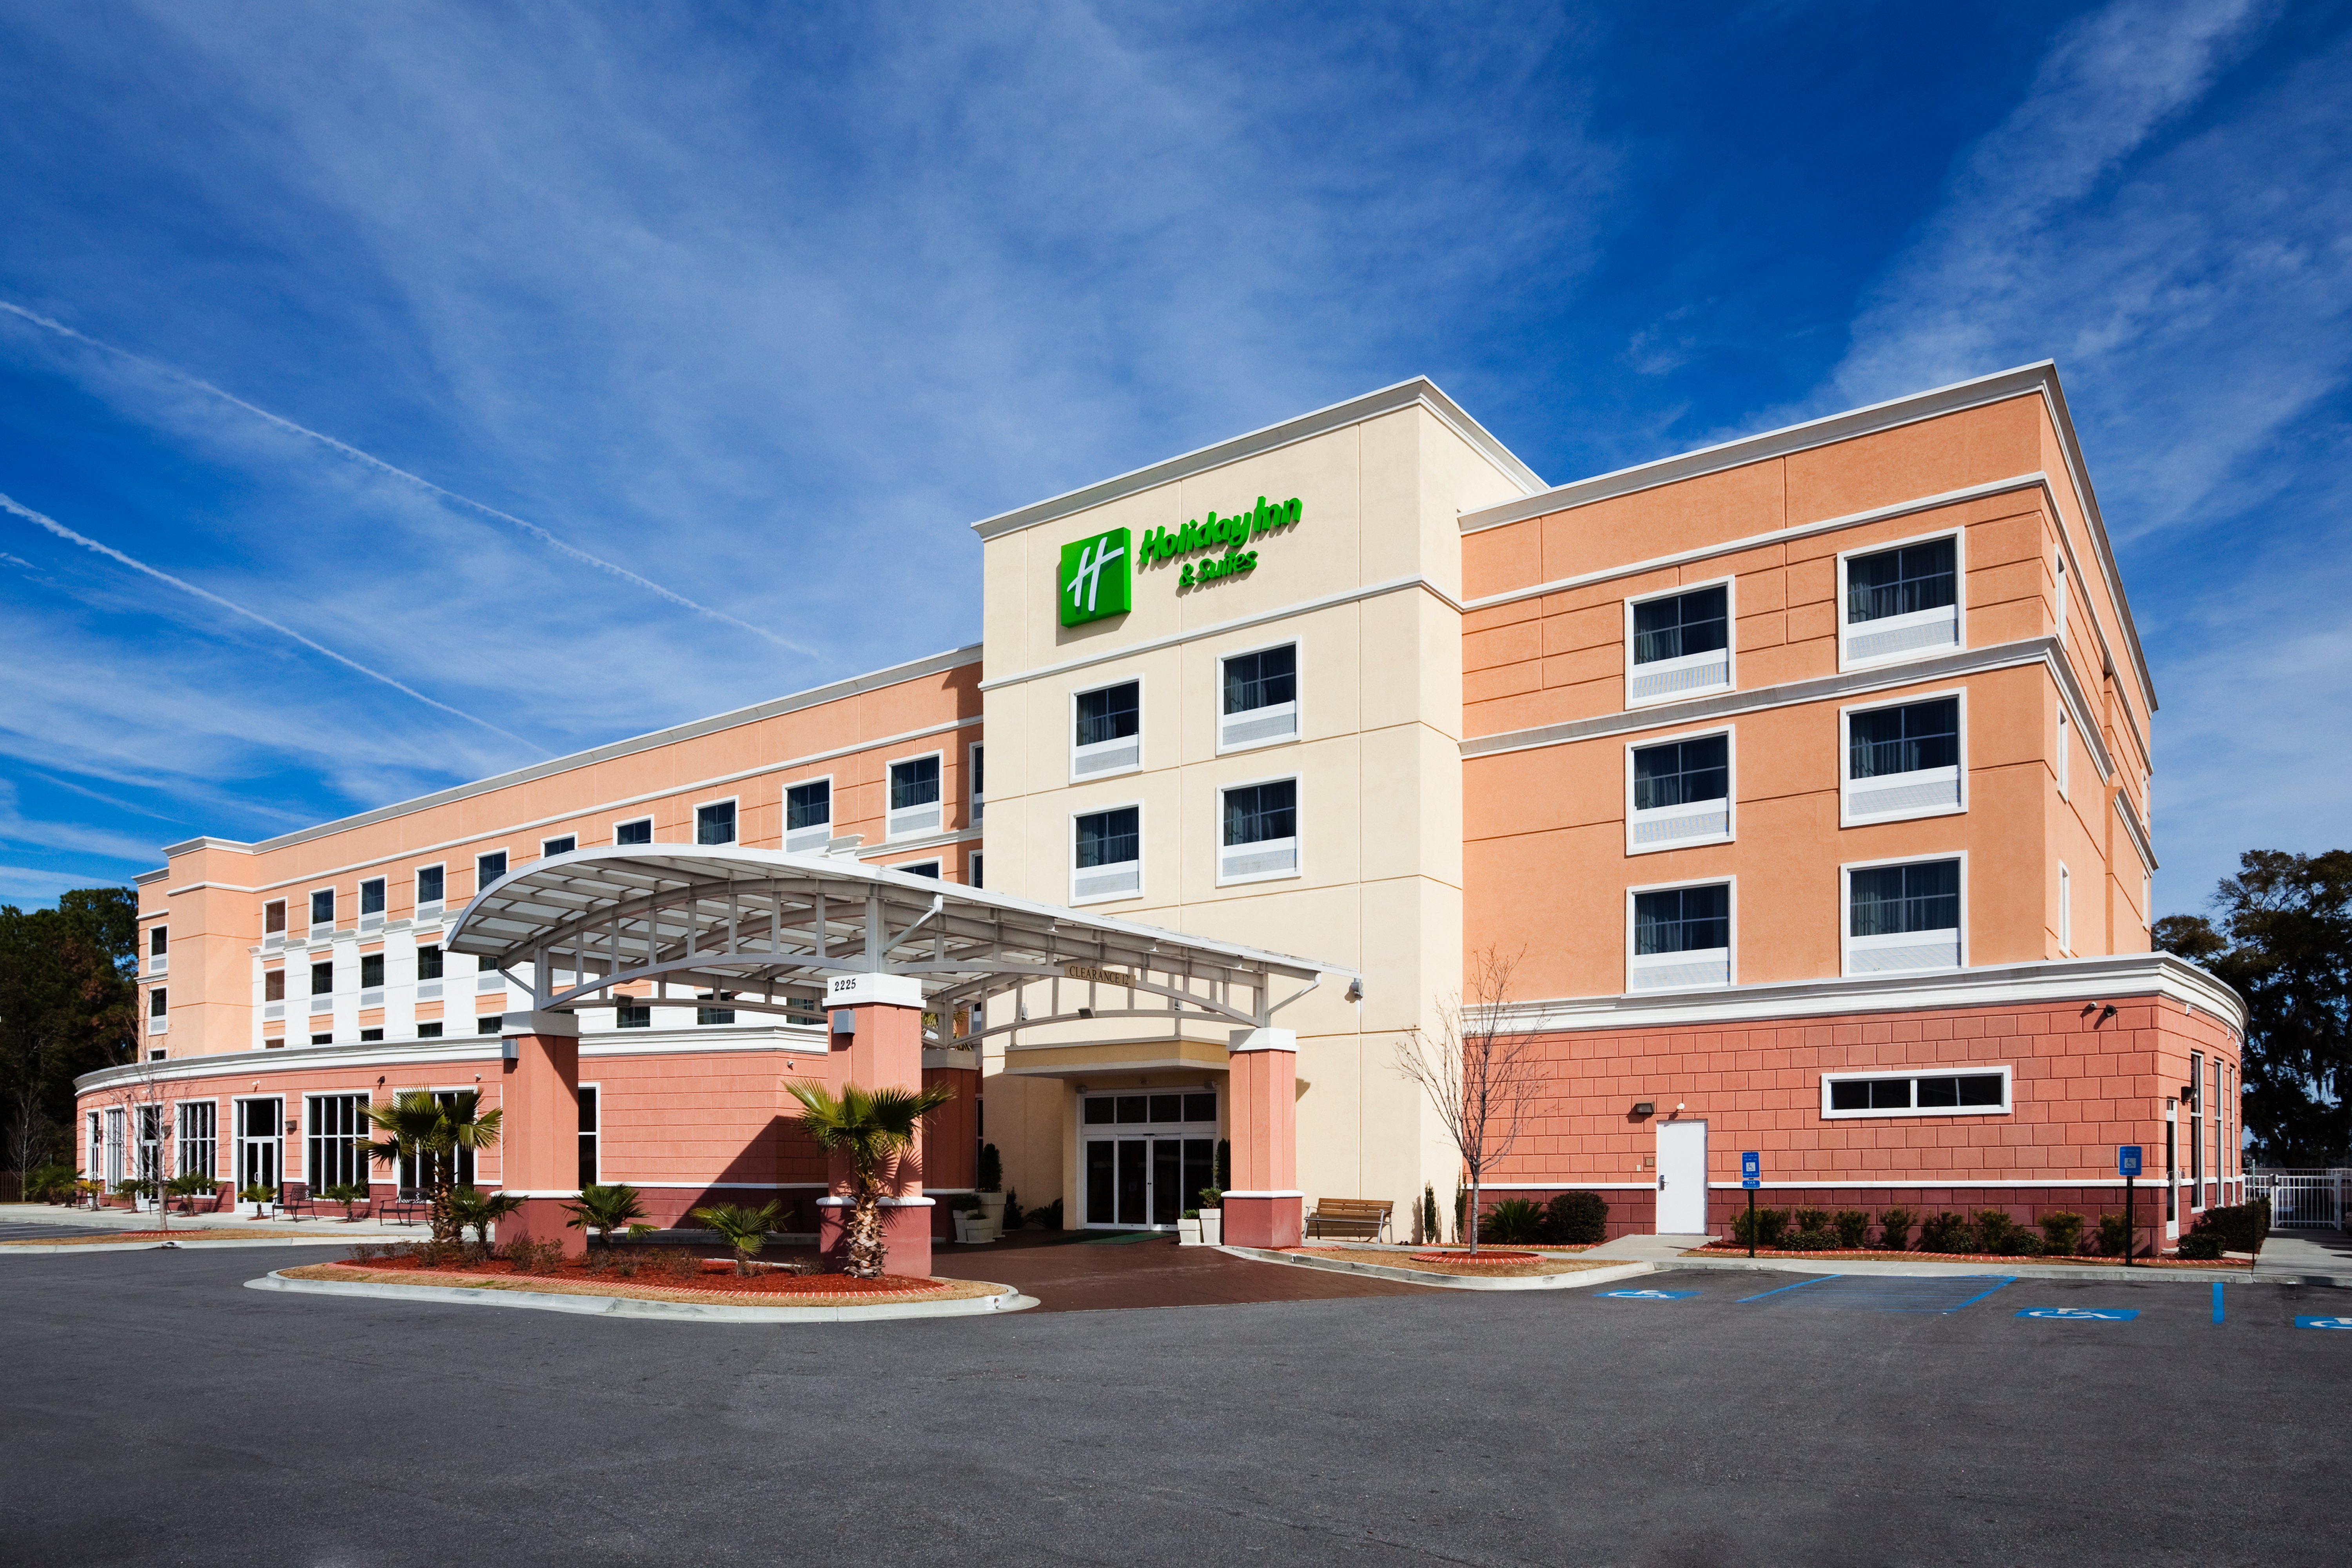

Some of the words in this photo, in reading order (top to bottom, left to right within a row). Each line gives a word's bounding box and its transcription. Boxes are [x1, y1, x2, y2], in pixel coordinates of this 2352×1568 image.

[1140, 511, 1252, 564] Holiday
[1253, 496, 1303, 533] Inn
[1179, 563, 1195, 587] &
[1196, 551, 1258, 582] Suites
[835, 978, 856, 992] 2225
[1069, 965, 1120, 984] CLEARANCE
